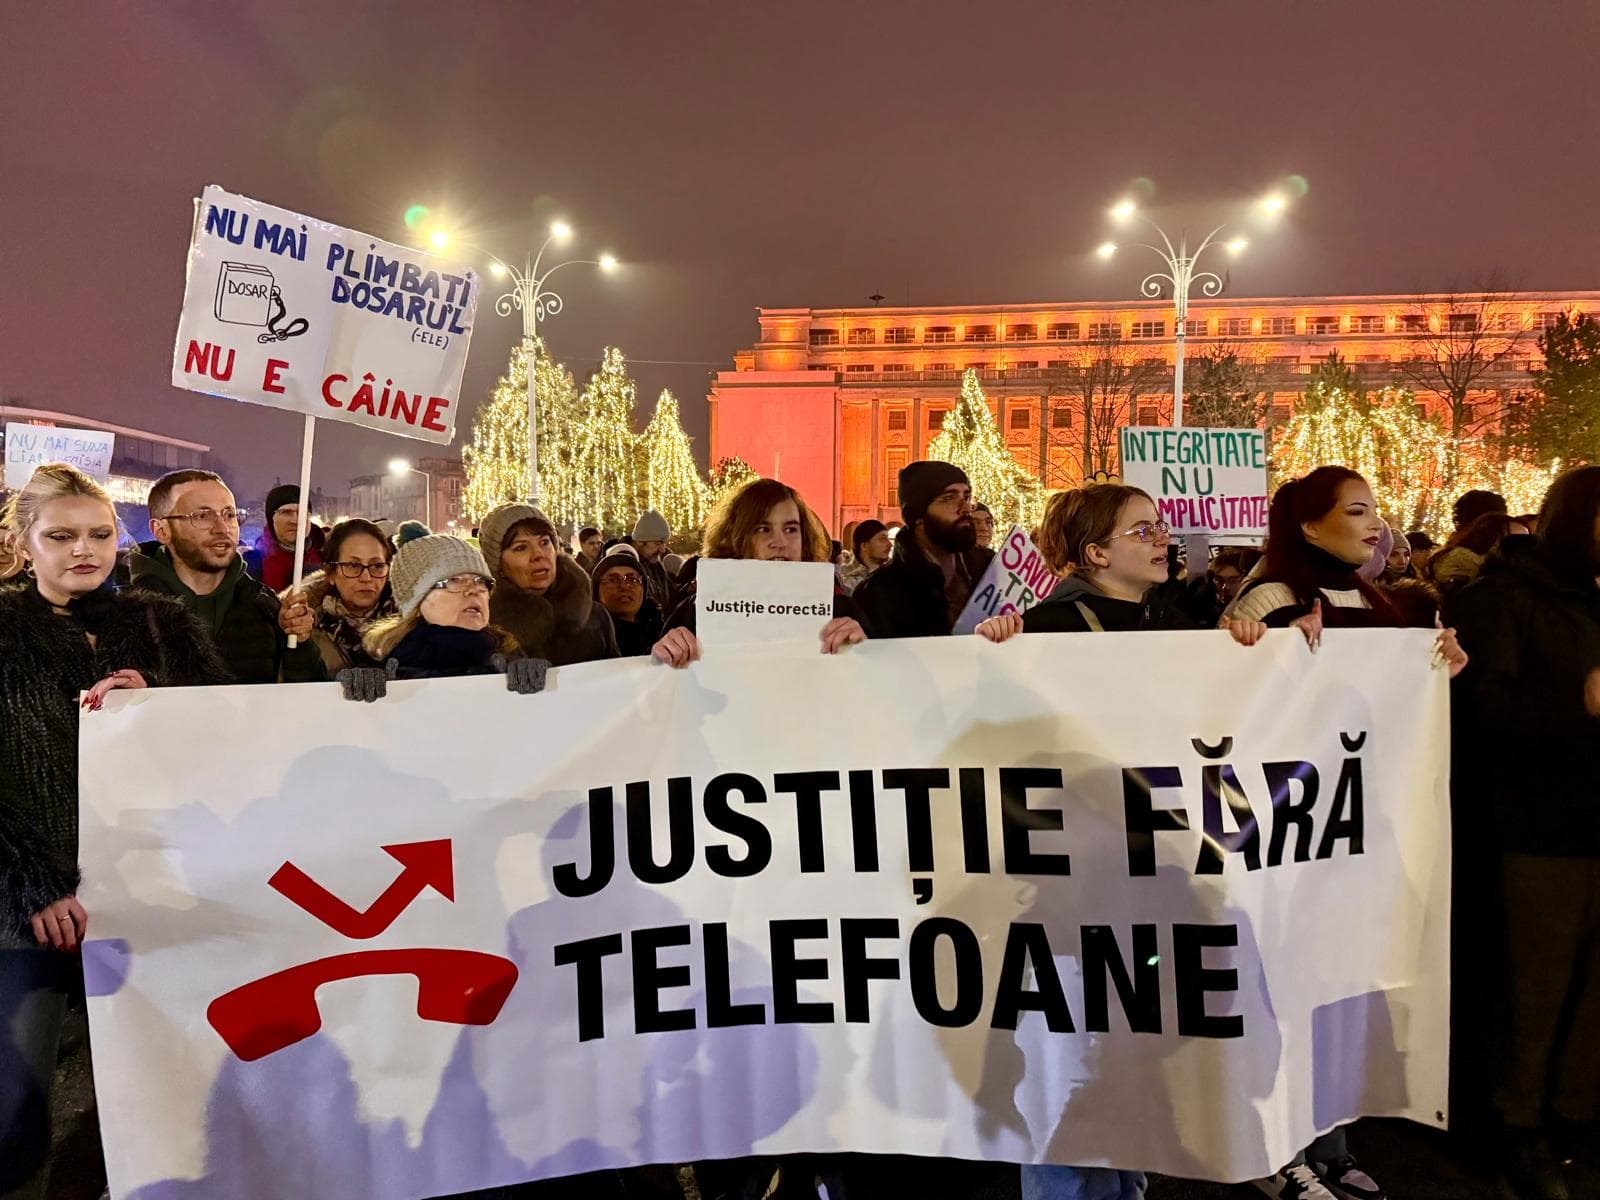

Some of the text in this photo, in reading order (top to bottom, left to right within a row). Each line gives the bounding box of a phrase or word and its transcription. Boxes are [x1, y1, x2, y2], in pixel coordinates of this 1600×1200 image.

[204, 205, 248, 245] NU
[254, 224, 307, 261] MAI
[228, 279, 268, 300] DOSAR
[411, 327, 449, 350] (-ELE)
[184, 339, 449, 432] NU E CÂINE
[9, 433, 37, 451] NU
[73, 439, 109, 453] SUNA
[1123, 427, 1265, 469] INTEGRITATE
[1161, 467, 1213, 496] NU
[1158, 494, 1269, 530] MPLICITATE
[1001, 532, 1060, 600] SAVO
[706, 600, 831, 617] Justiție corectă!
[552, 731, 1367, 906] JUSTIȚIE FĂRĂ
[554, 916, 1244, 1043] TELEFOANE
